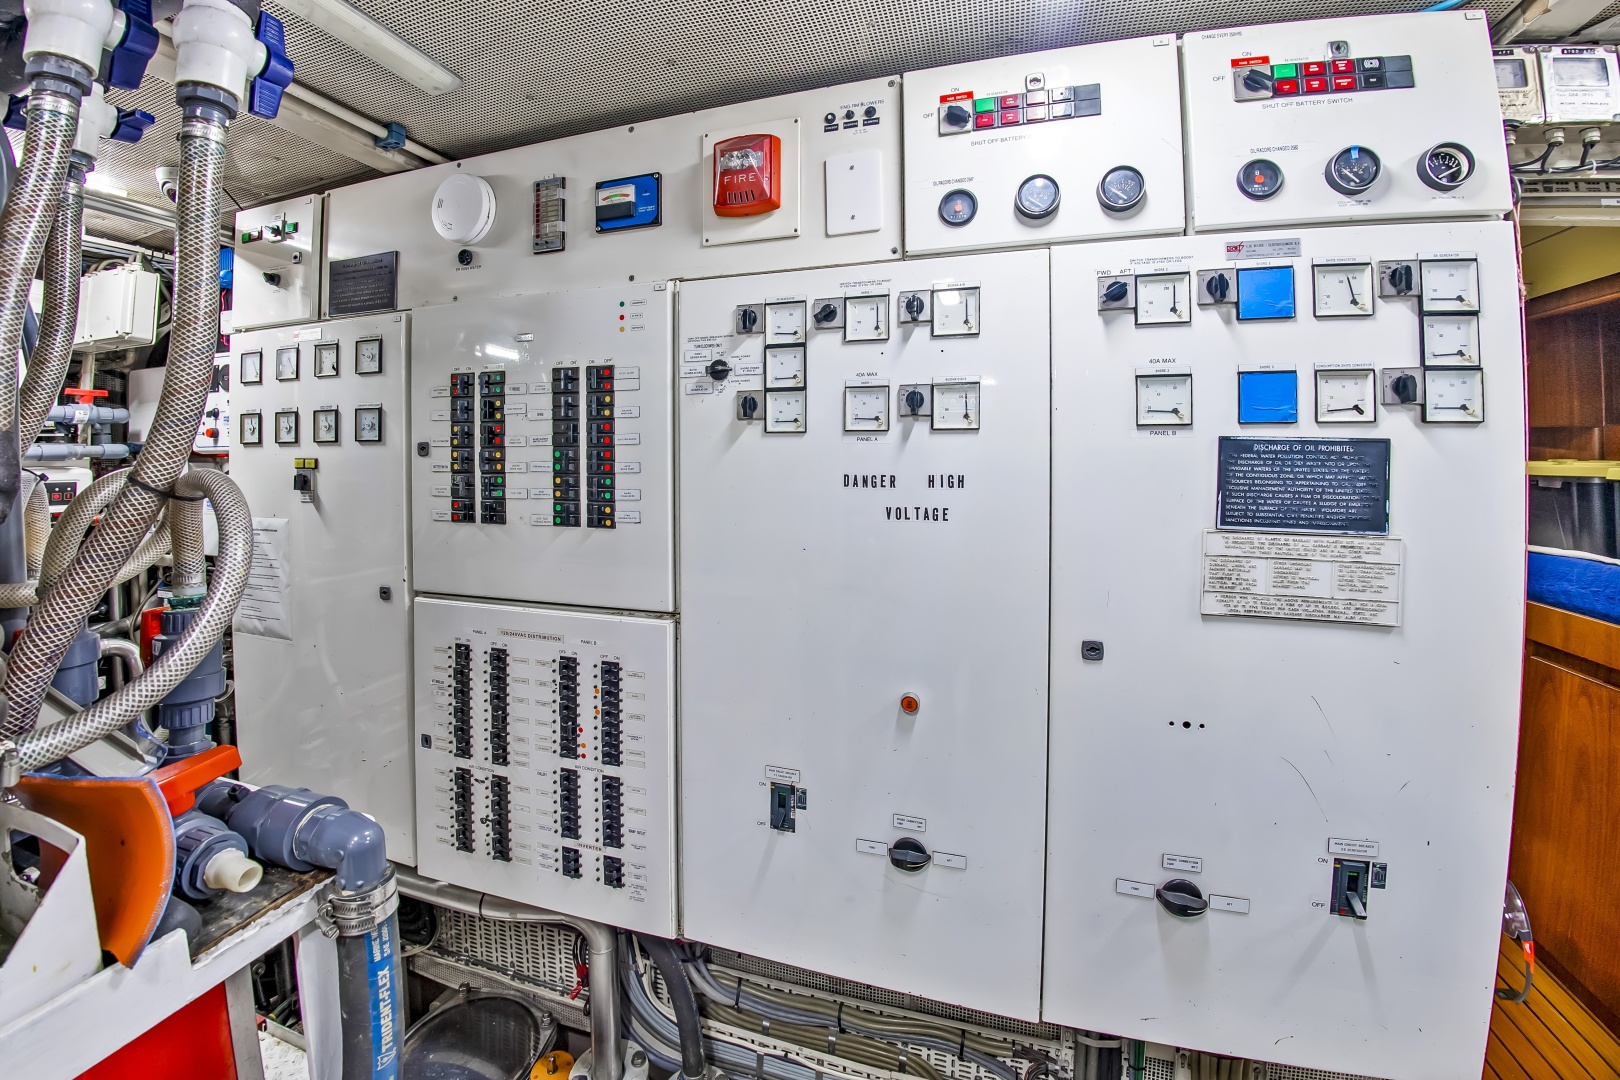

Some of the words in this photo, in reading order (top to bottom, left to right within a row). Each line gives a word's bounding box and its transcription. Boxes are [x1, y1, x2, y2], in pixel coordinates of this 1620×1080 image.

[724, 172, 756, 185] FIRE
[844, 474, 896, 488] DANGER
[928, 475, 964, 488] HIGH
[886, 507, 949, 521] VOLTAGE
[378, 966, 393, 1053] TRIDENT-FLEX
